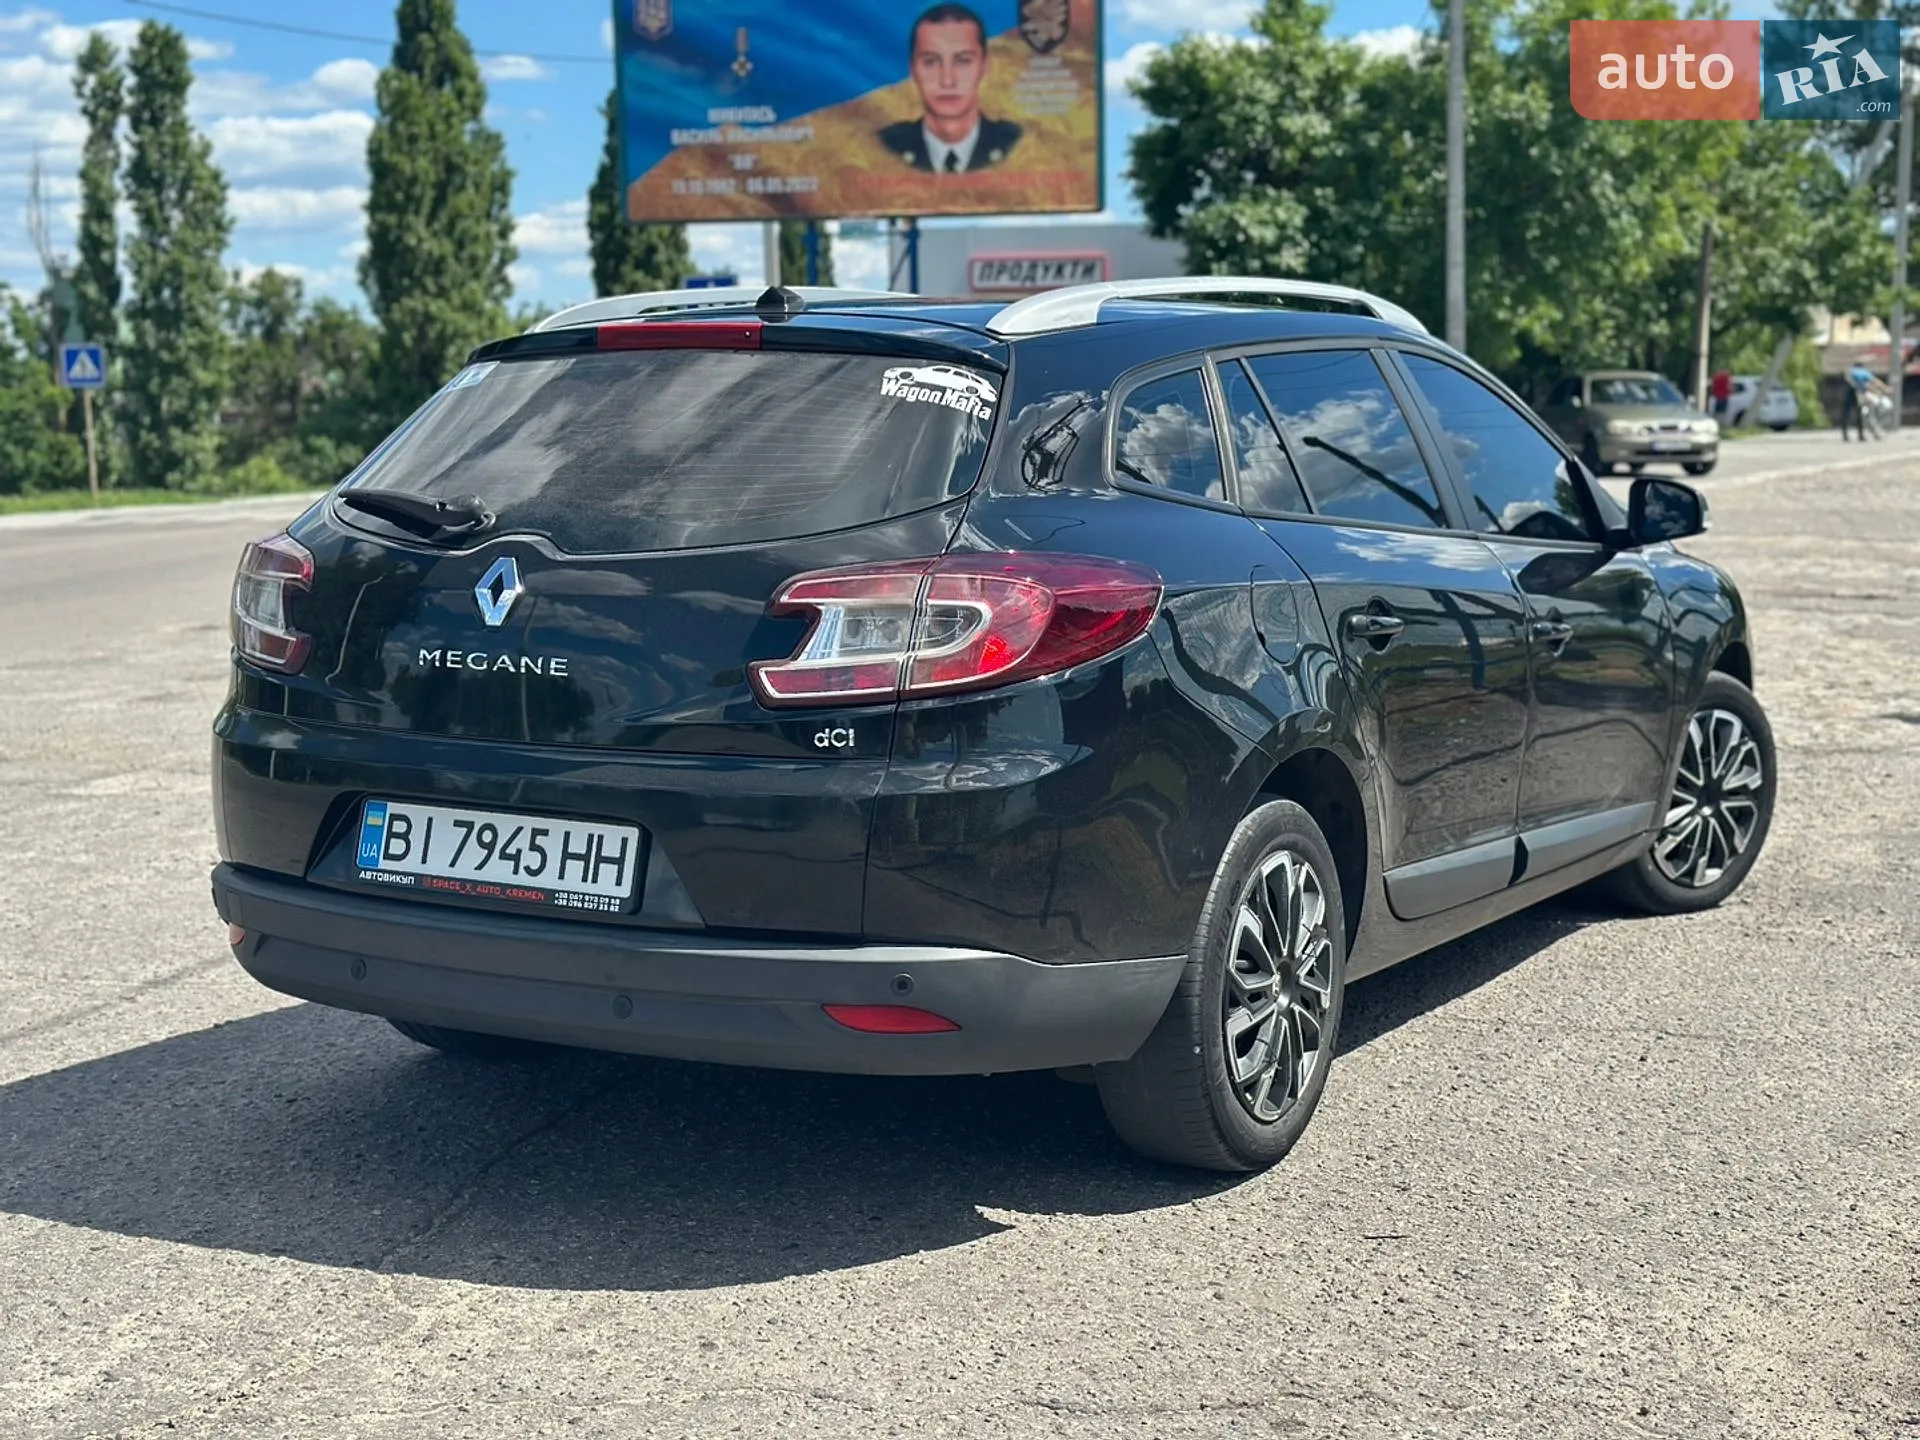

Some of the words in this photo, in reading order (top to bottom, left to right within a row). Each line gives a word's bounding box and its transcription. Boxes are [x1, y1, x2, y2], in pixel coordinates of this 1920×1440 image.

[977, 260, 1097, 286] ПРОДУКТИ
[418, 648, 569, 677] MEGANE
[361, 843, 379, 859] UA
[448, 819, 550, 877] 7945
[558, 831, 629, 887] HH
[359, 871, 415, 885] АВТОВИКУП
